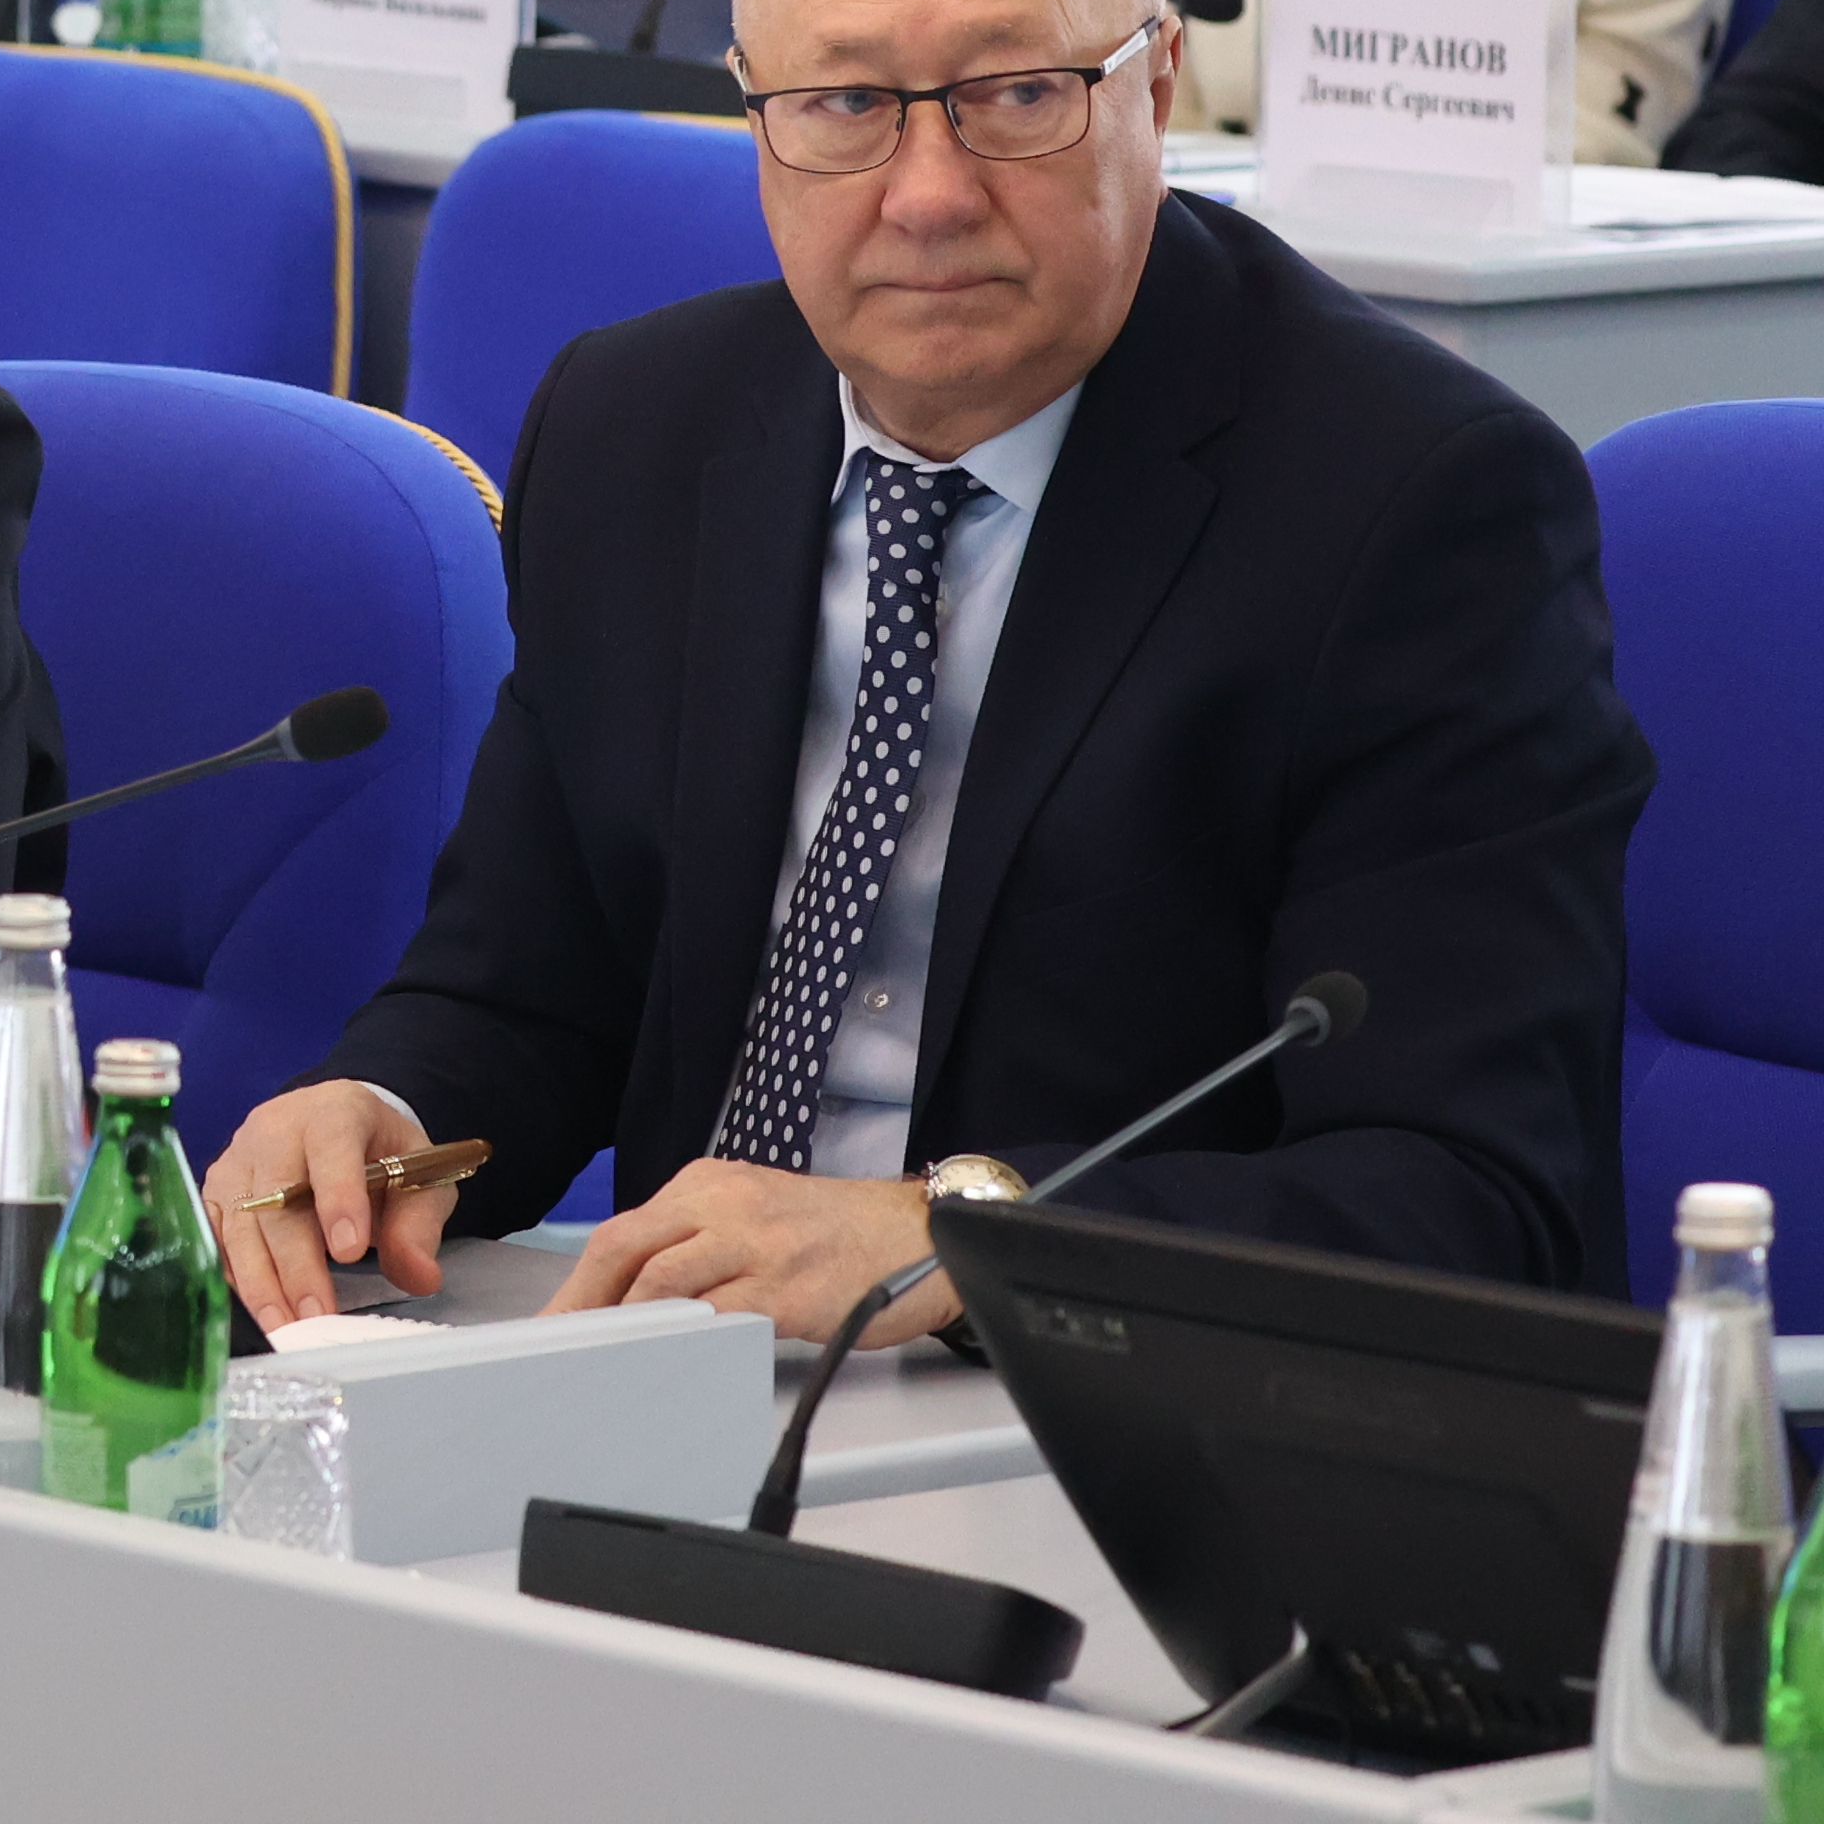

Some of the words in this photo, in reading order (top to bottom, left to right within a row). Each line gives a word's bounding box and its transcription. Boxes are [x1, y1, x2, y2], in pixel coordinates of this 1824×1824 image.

[1310, 24, 1508, 75] МИГРАНОВ
[1302, 75, 1375, 106] Денис
[1381, 85, 1515, 121] Сергеевич
